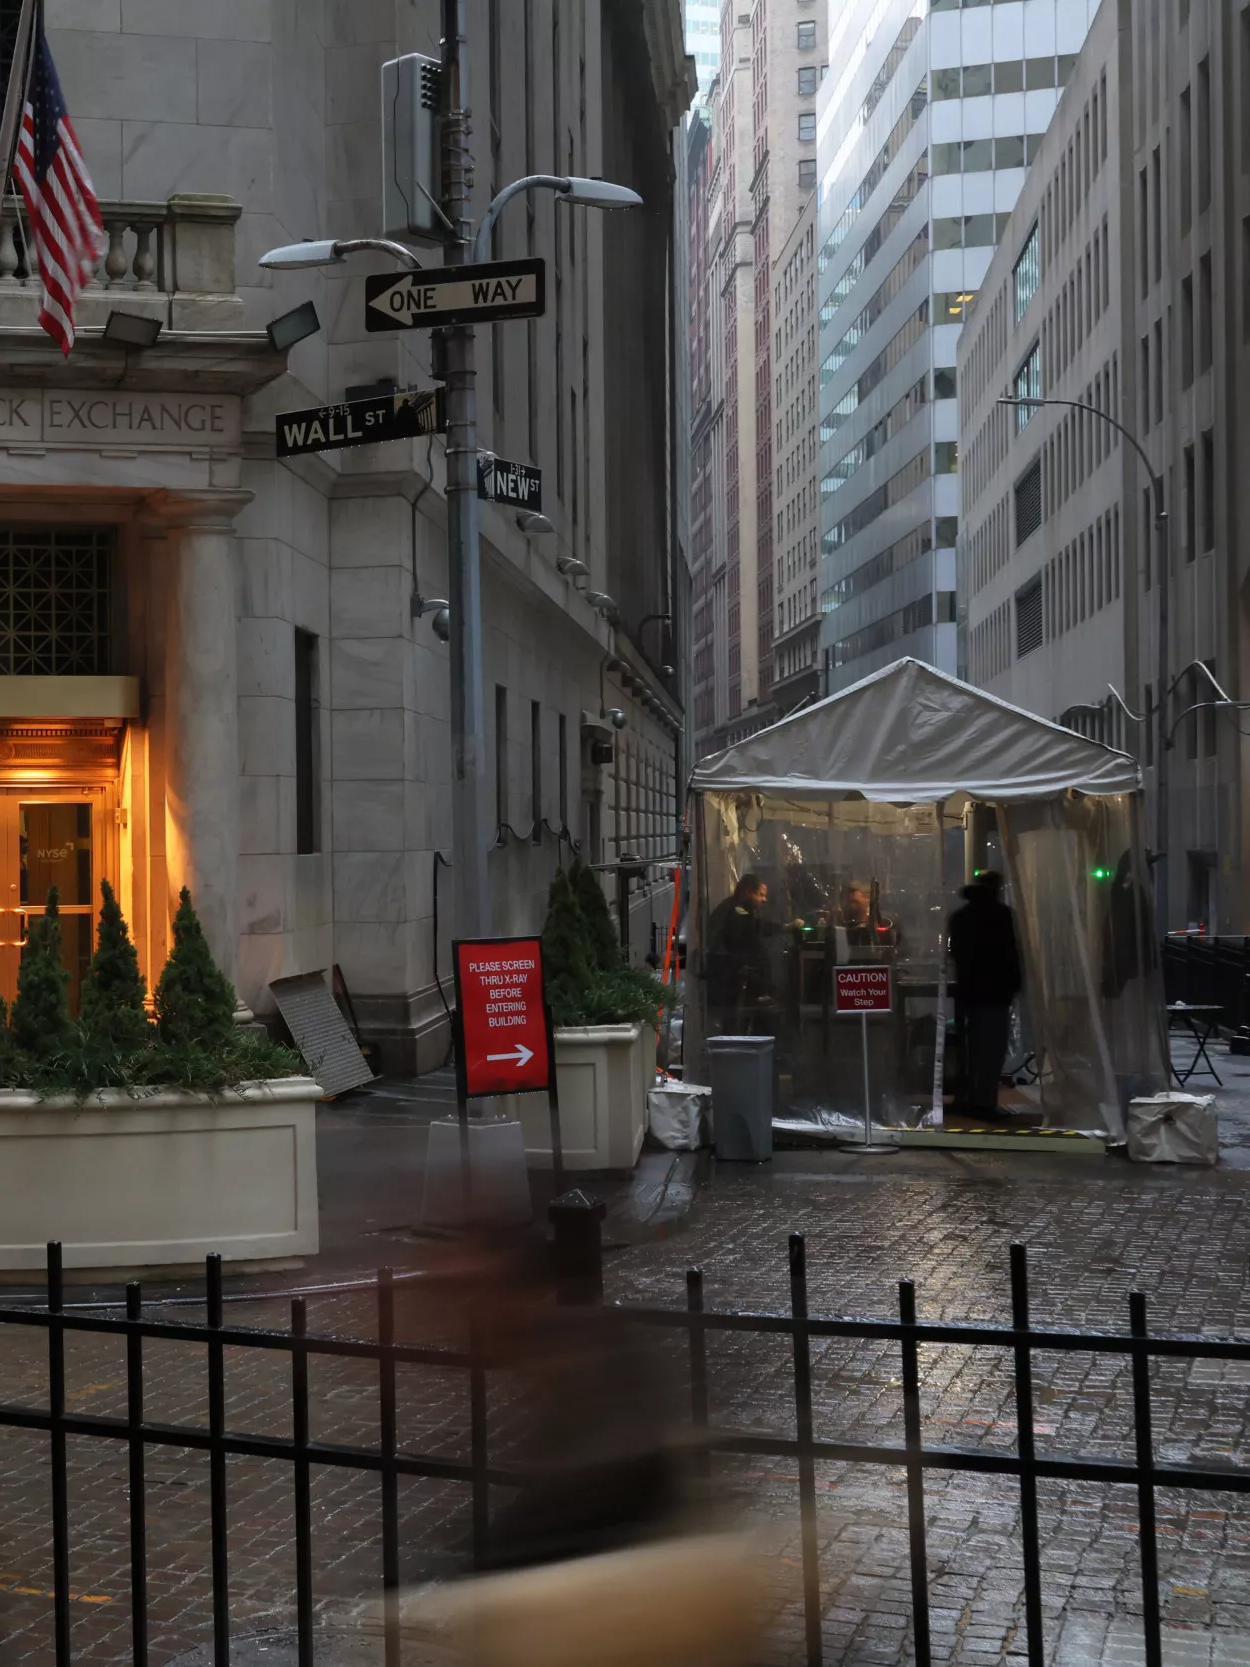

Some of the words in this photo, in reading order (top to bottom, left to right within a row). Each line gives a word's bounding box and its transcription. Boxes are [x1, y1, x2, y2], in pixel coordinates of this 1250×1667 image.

[389, 287, 437, 313] ONE
[472, 278, 523, 305] WAY
[47, 399, 225, 433] EXCHANGE
[328, 404, 350, 418] 9-15
[283, 415, 363, 448] WALL
[365, 410, 386, 426] ST
[496, 470, 530, 501] NEW
[530, 479, 540, 492] ST
[469, 961, 501, 973] PLEASE
[502, 959, 535, 971] SCREEN
[479, 975, 503, 985] THRU
[505, 974, 528, 985] X-RAY
[838, 972, 887, 983] CAUTION
[489, 987, 522, 999] BEFORE
[840, 988, 867, 997] Watch
[868, 988, 886, 996] Your
[486, 1001, 526, 1013] ENTERING
[854, 998, 875, 1007] Step
[488, 1015, 526, 1027] BUILDING
